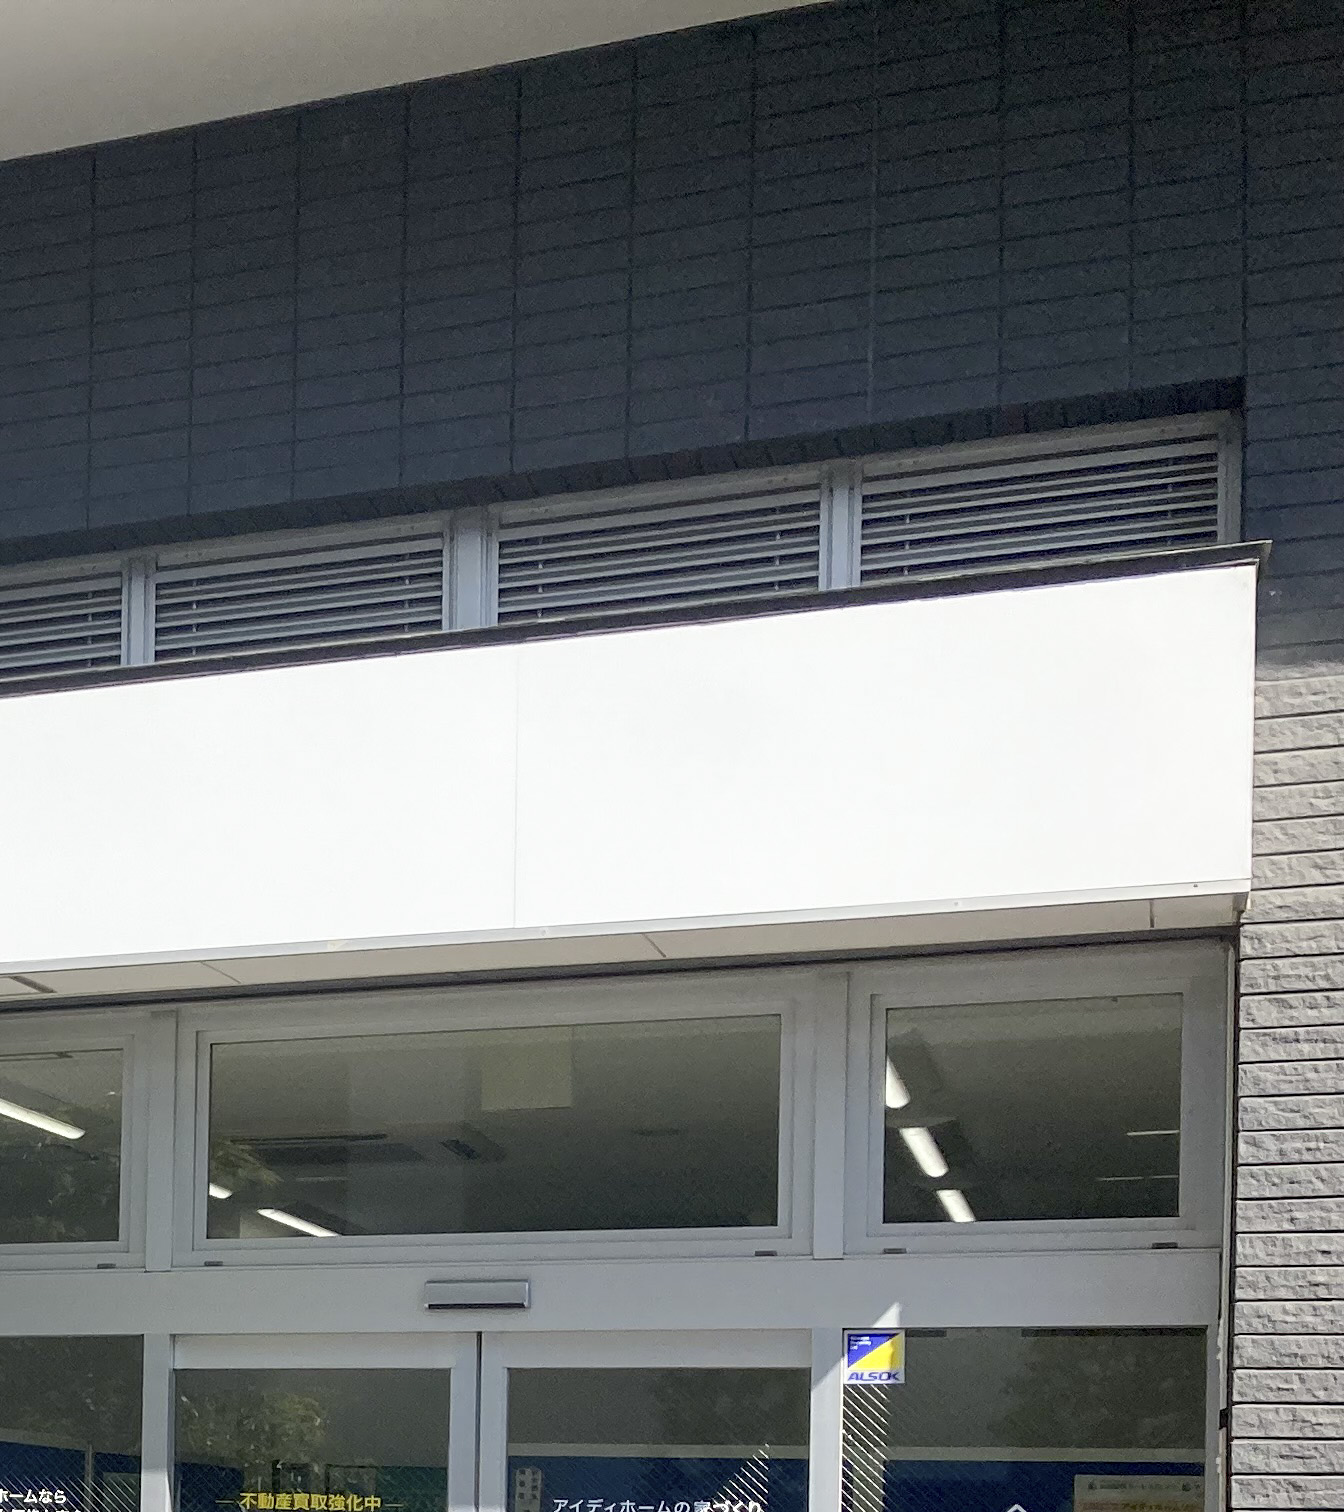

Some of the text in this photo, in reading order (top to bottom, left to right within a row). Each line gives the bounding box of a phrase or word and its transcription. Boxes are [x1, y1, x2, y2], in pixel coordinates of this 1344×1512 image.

[848, 1371, 901, 1381] ALSOK
[238, 1492, 382, 1512] 不動産買取強化中
